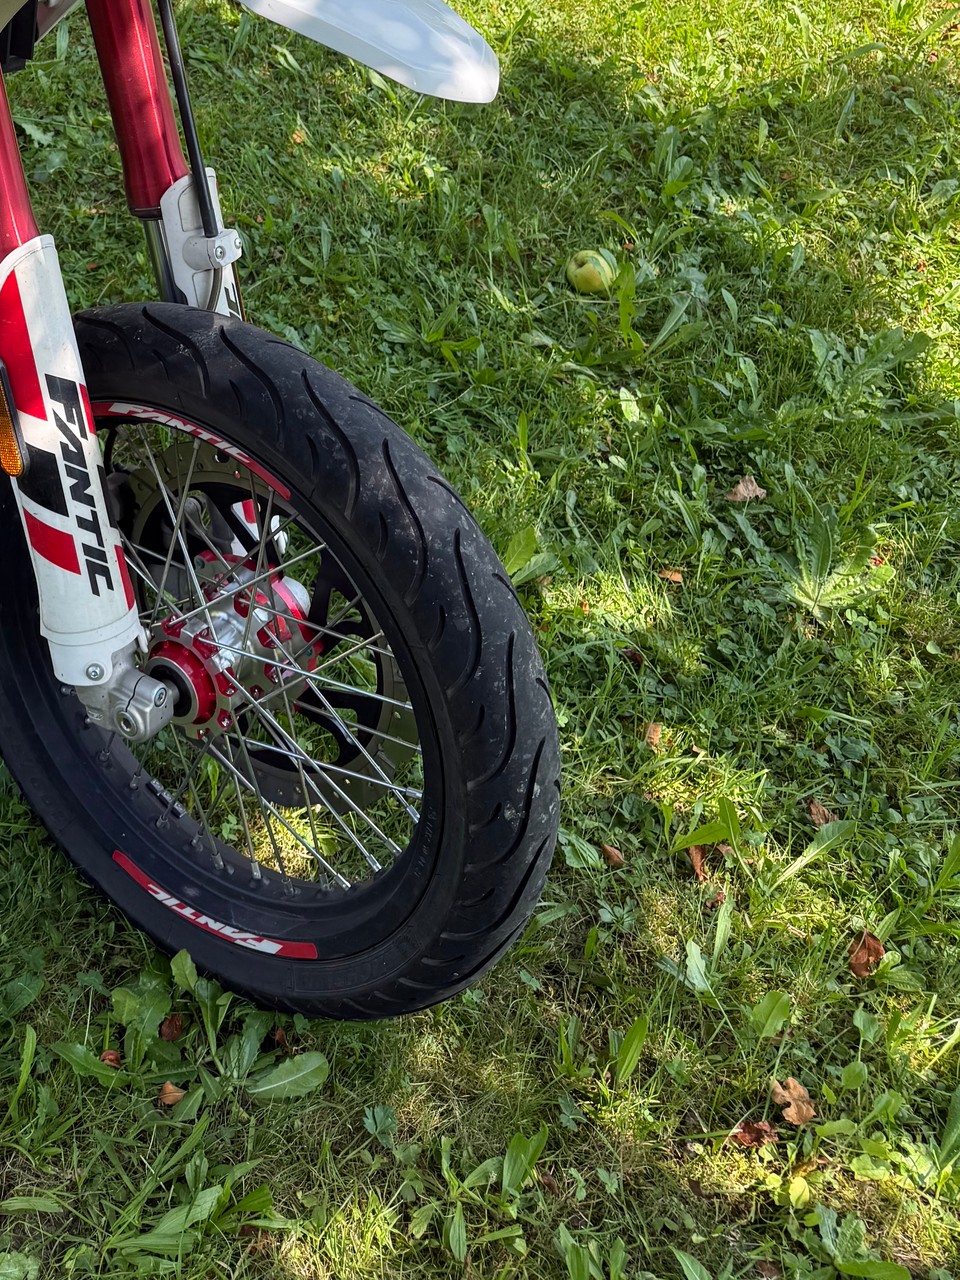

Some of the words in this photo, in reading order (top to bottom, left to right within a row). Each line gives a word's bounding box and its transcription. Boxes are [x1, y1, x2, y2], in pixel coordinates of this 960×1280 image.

[108, 402, 250, 464] FANTIC
[45, 373, 115, 597] FANTIC
[147, 883, 283, 955] FANTIC
